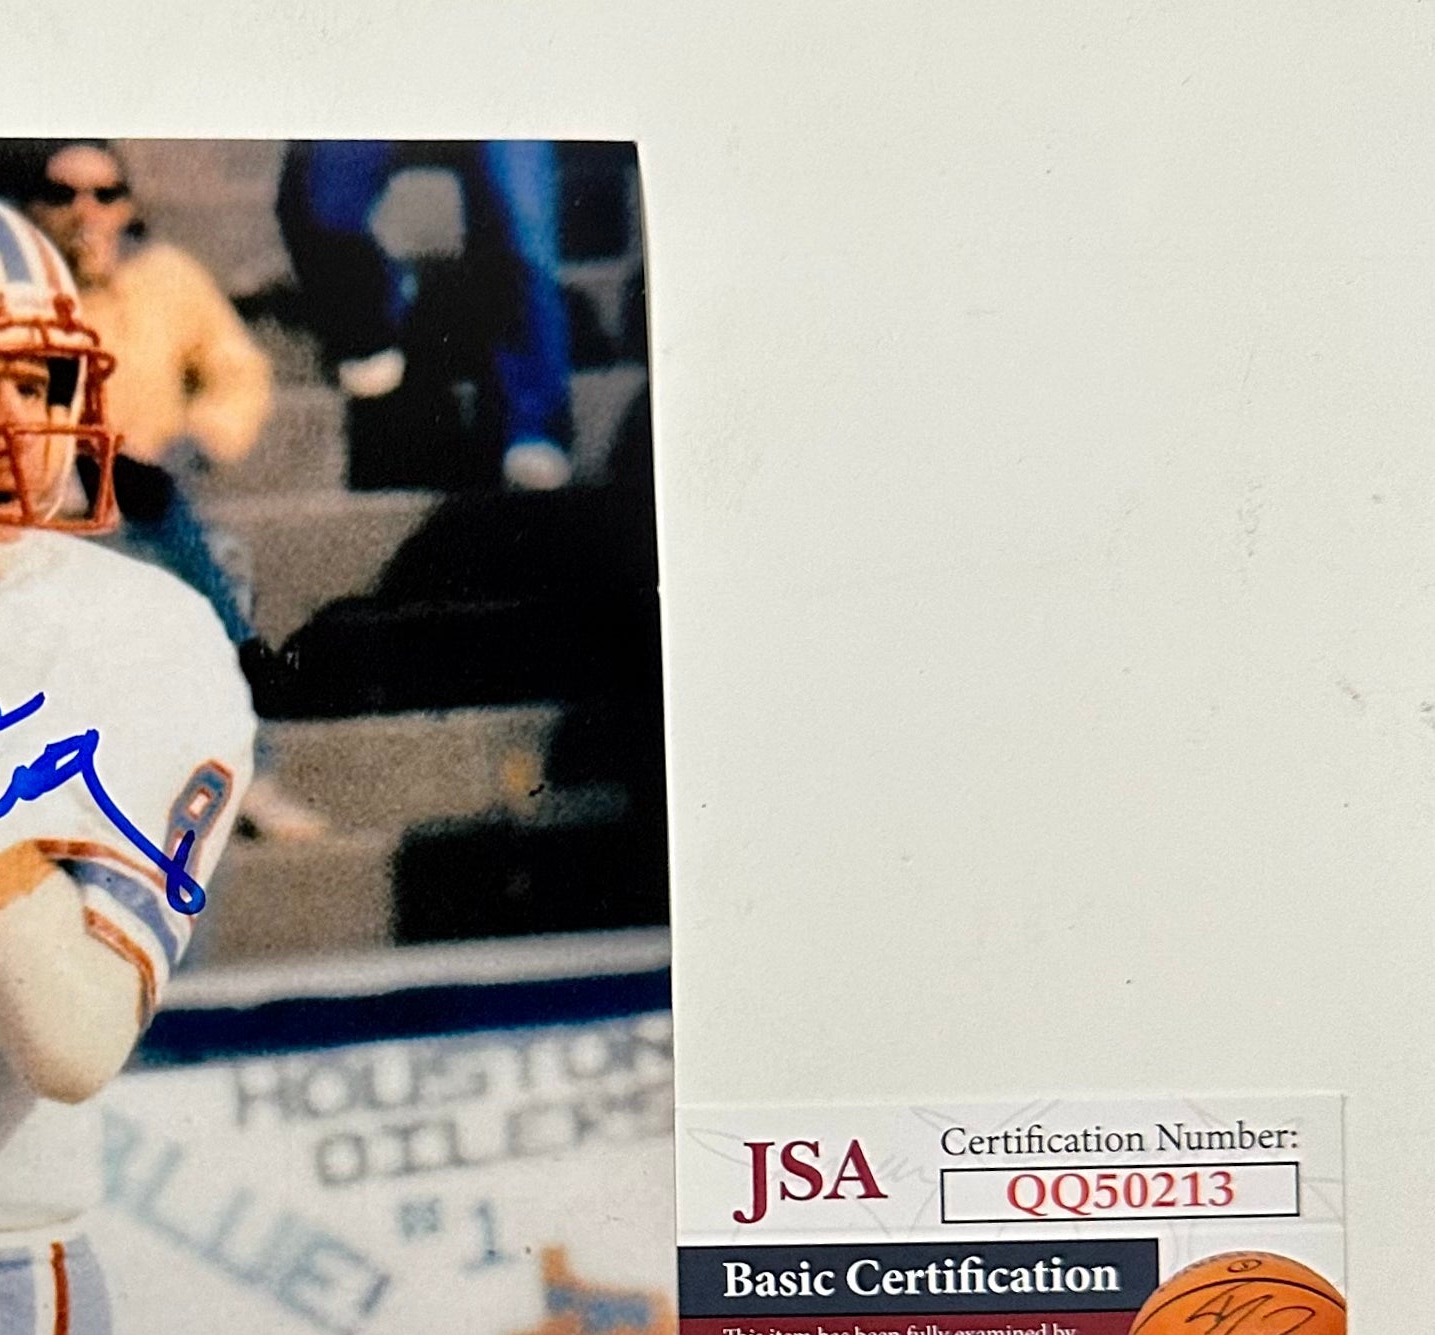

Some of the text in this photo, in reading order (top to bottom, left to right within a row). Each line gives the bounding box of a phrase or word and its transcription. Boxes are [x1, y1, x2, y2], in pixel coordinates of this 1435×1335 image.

[940, 1119, 1300, 1157] Certification Number:
[732, 1138, 889, 1224] JSA
[1006, 1170, 1236, 1218] QQ50213
[722, 1256, 1121, 1298] Basic Certification
